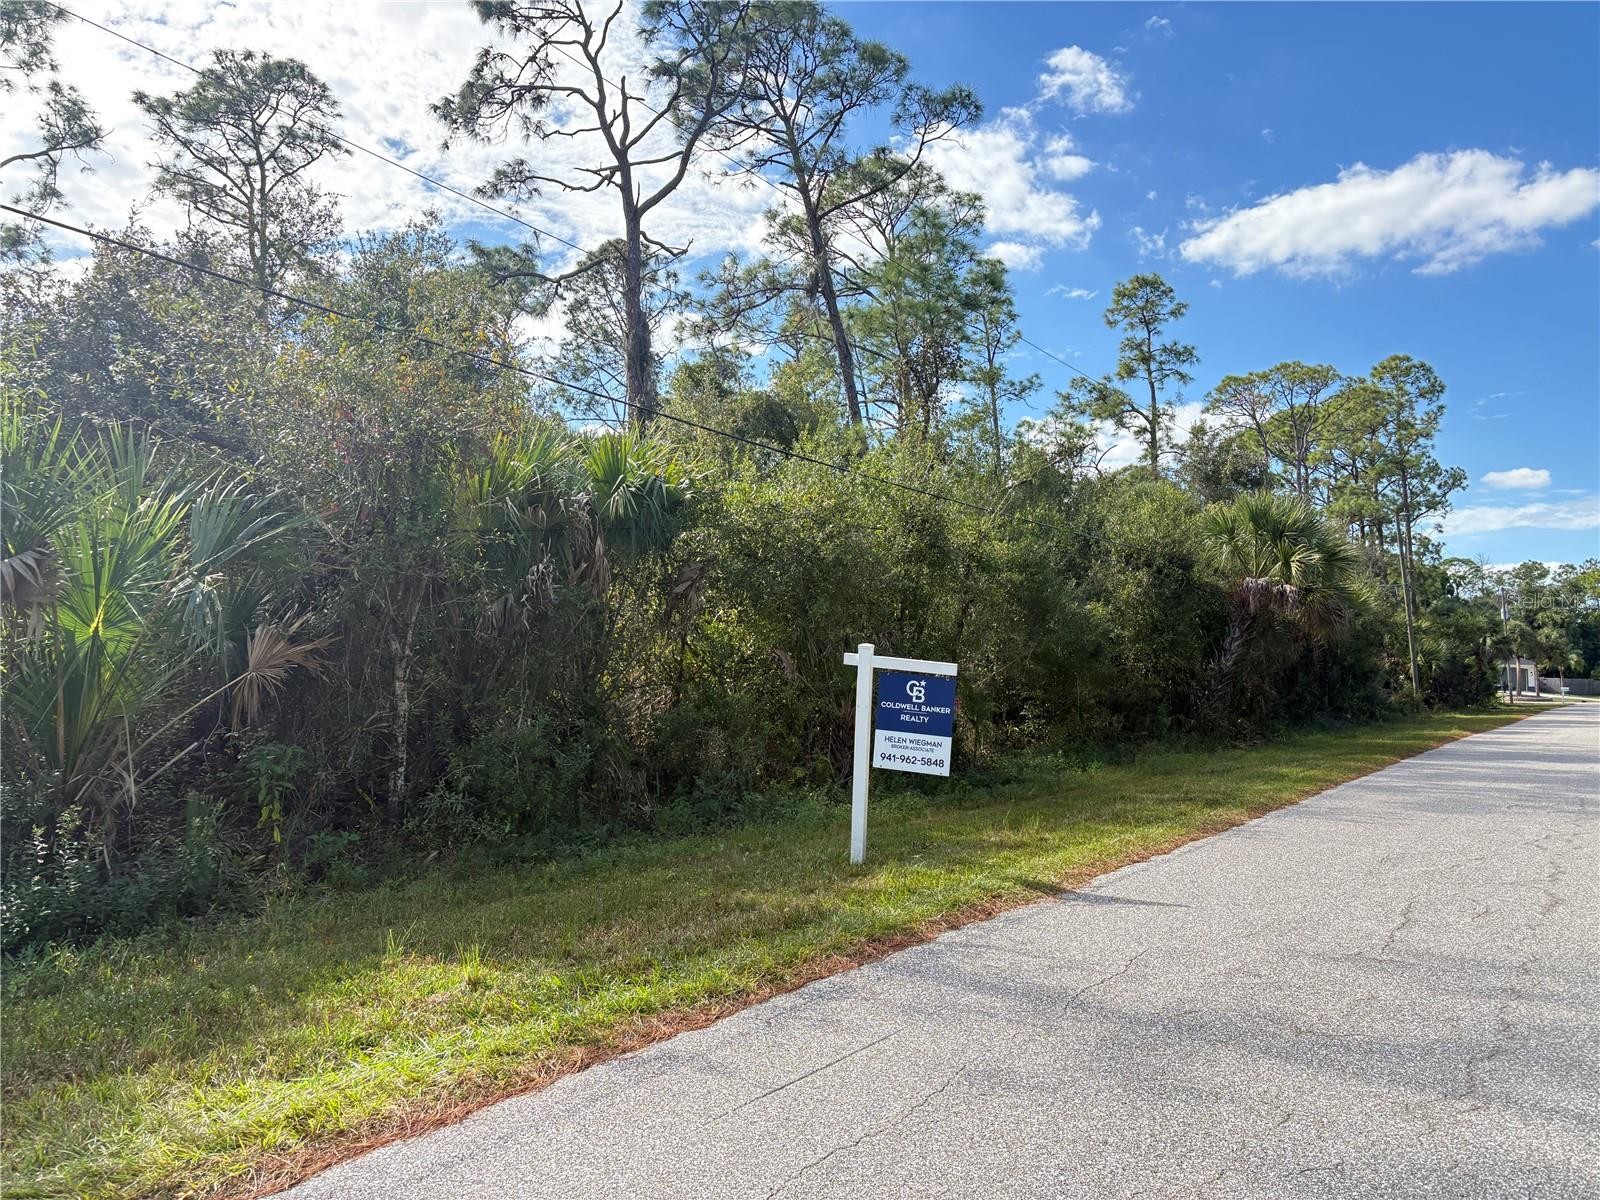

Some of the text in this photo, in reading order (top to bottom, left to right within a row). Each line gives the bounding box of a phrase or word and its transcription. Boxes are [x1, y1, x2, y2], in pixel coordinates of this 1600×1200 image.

[906, 680, 925, 703] CB
[881, 701, 951, 714] COLDWELL BANKER
[900, 714, 929, 723] REALTY
[884, 736, 943, 748] HELEN WIEGMAN
[880, 752, 945, 768] 941-962-5848
